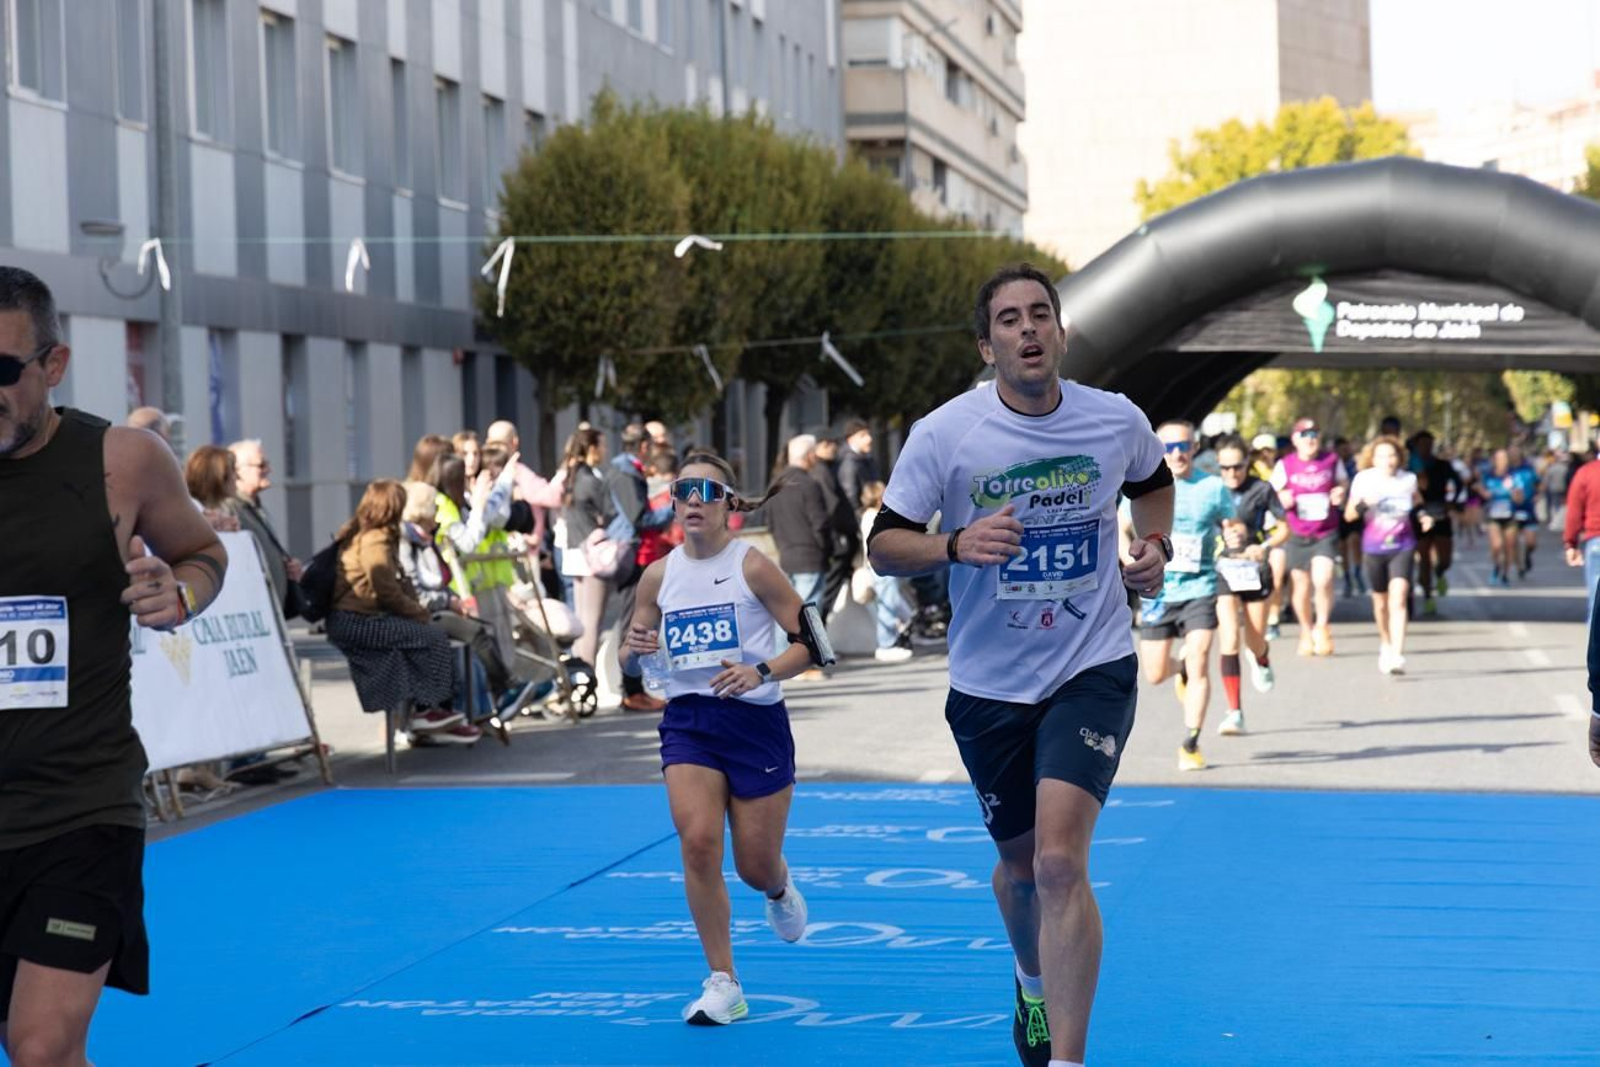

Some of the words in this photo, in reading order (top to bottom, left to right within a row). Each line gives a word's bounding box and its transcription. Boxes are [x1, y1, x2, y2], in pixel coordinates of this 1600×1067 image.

[1419, 302, 1499, 323] Municipal
[1500, 303, 1525, 321] de
[1336, 319, 1413, 340] Deportes
[1413, 320, 1438, 339] de
[973, 470, 1090, 494] Torreolivo
[1006, 539, 1091, 572] 2151
[667, 619, 732, 649] 2438
